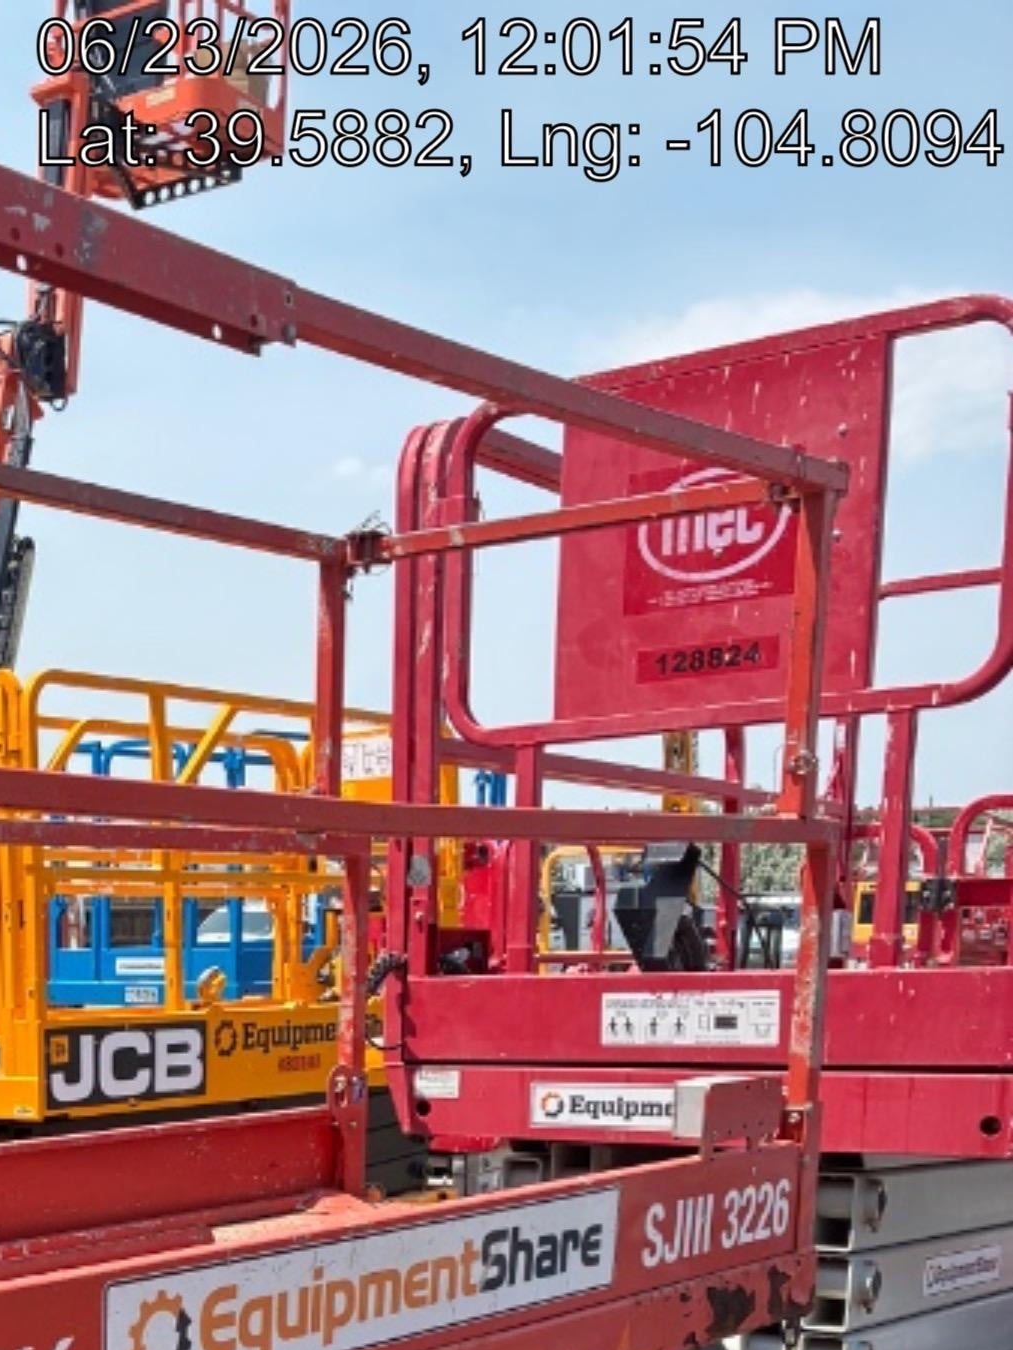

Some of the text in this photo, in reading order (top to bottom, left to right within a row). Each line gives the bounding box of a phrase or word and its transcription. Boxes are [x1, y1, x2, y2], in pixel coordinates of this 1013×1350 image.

[654, 642, 762, 675] 128824
[242, 1019, 337, 1053] Equipme
[49, 1028, 204, 1102] JCB
[721, 1180, 791, 1252] 3226
